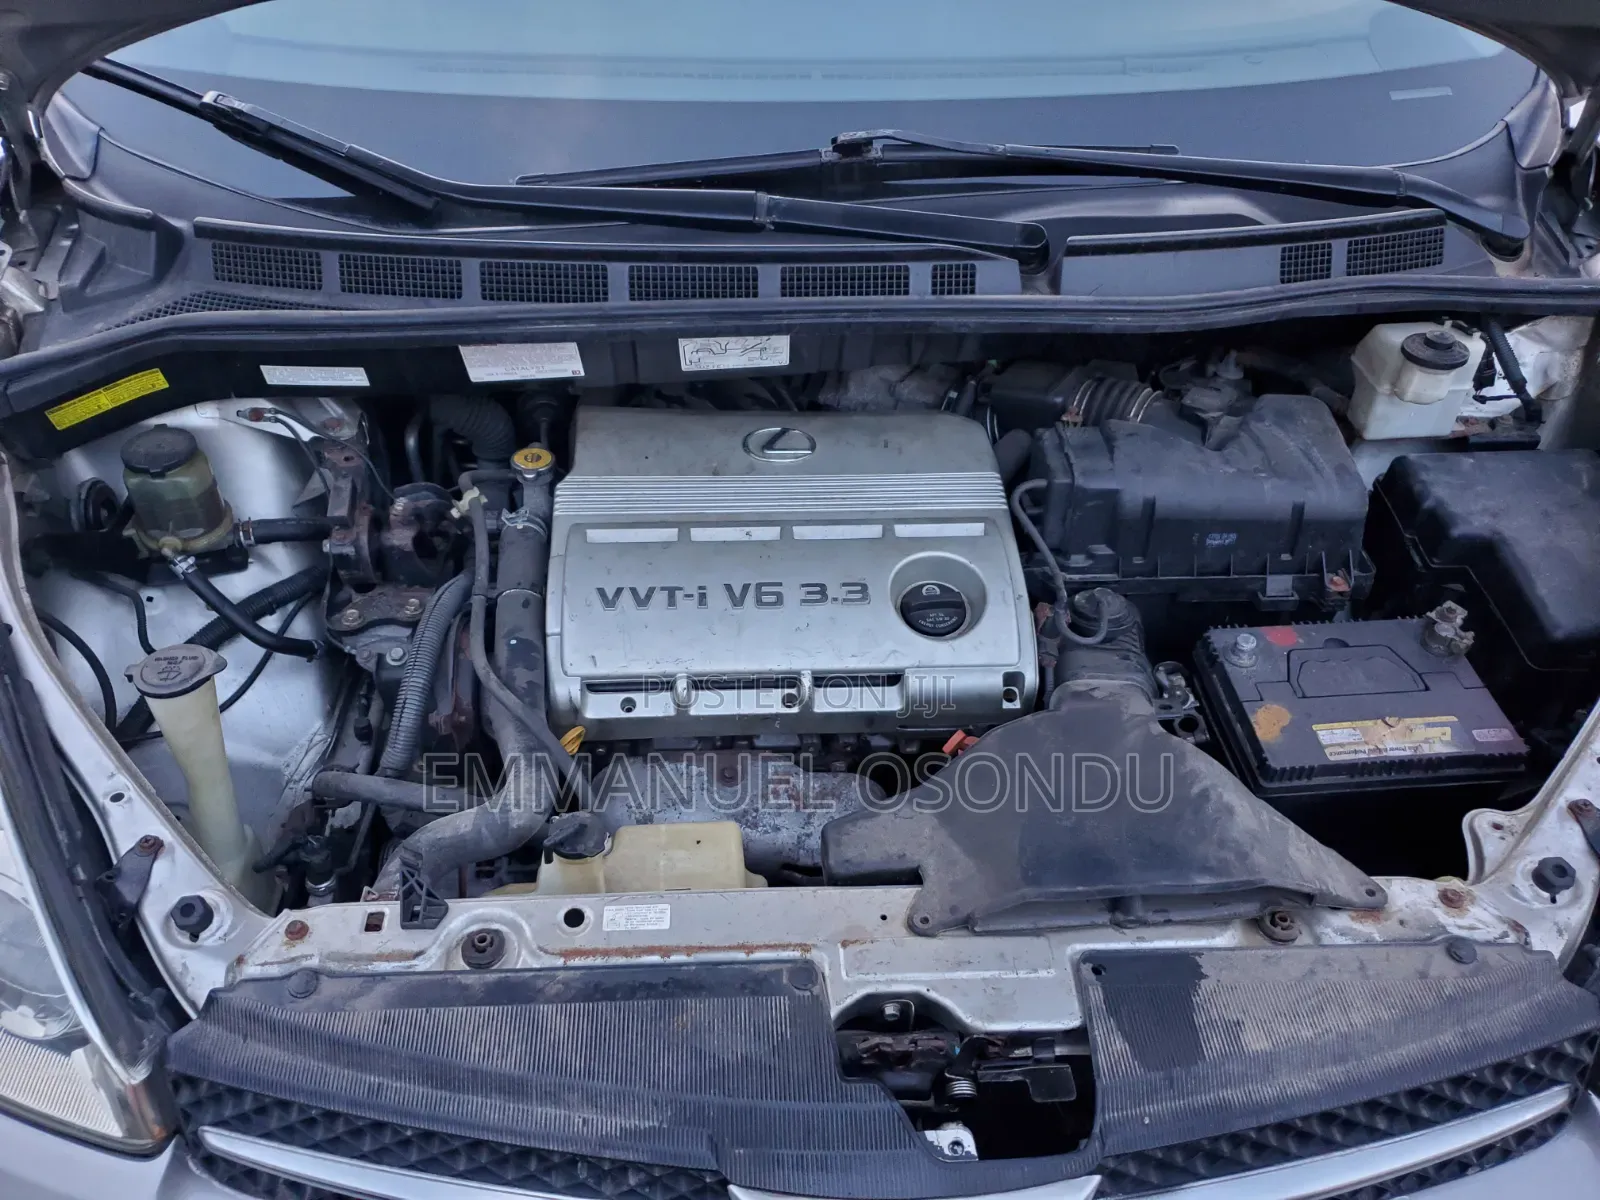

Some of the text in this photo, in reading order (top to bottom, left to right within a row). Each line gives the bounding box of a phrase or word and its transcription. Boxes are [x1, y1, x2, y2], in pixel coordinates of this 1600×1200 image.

[595, 581, 872, 611] VVT-i V6 3.3
